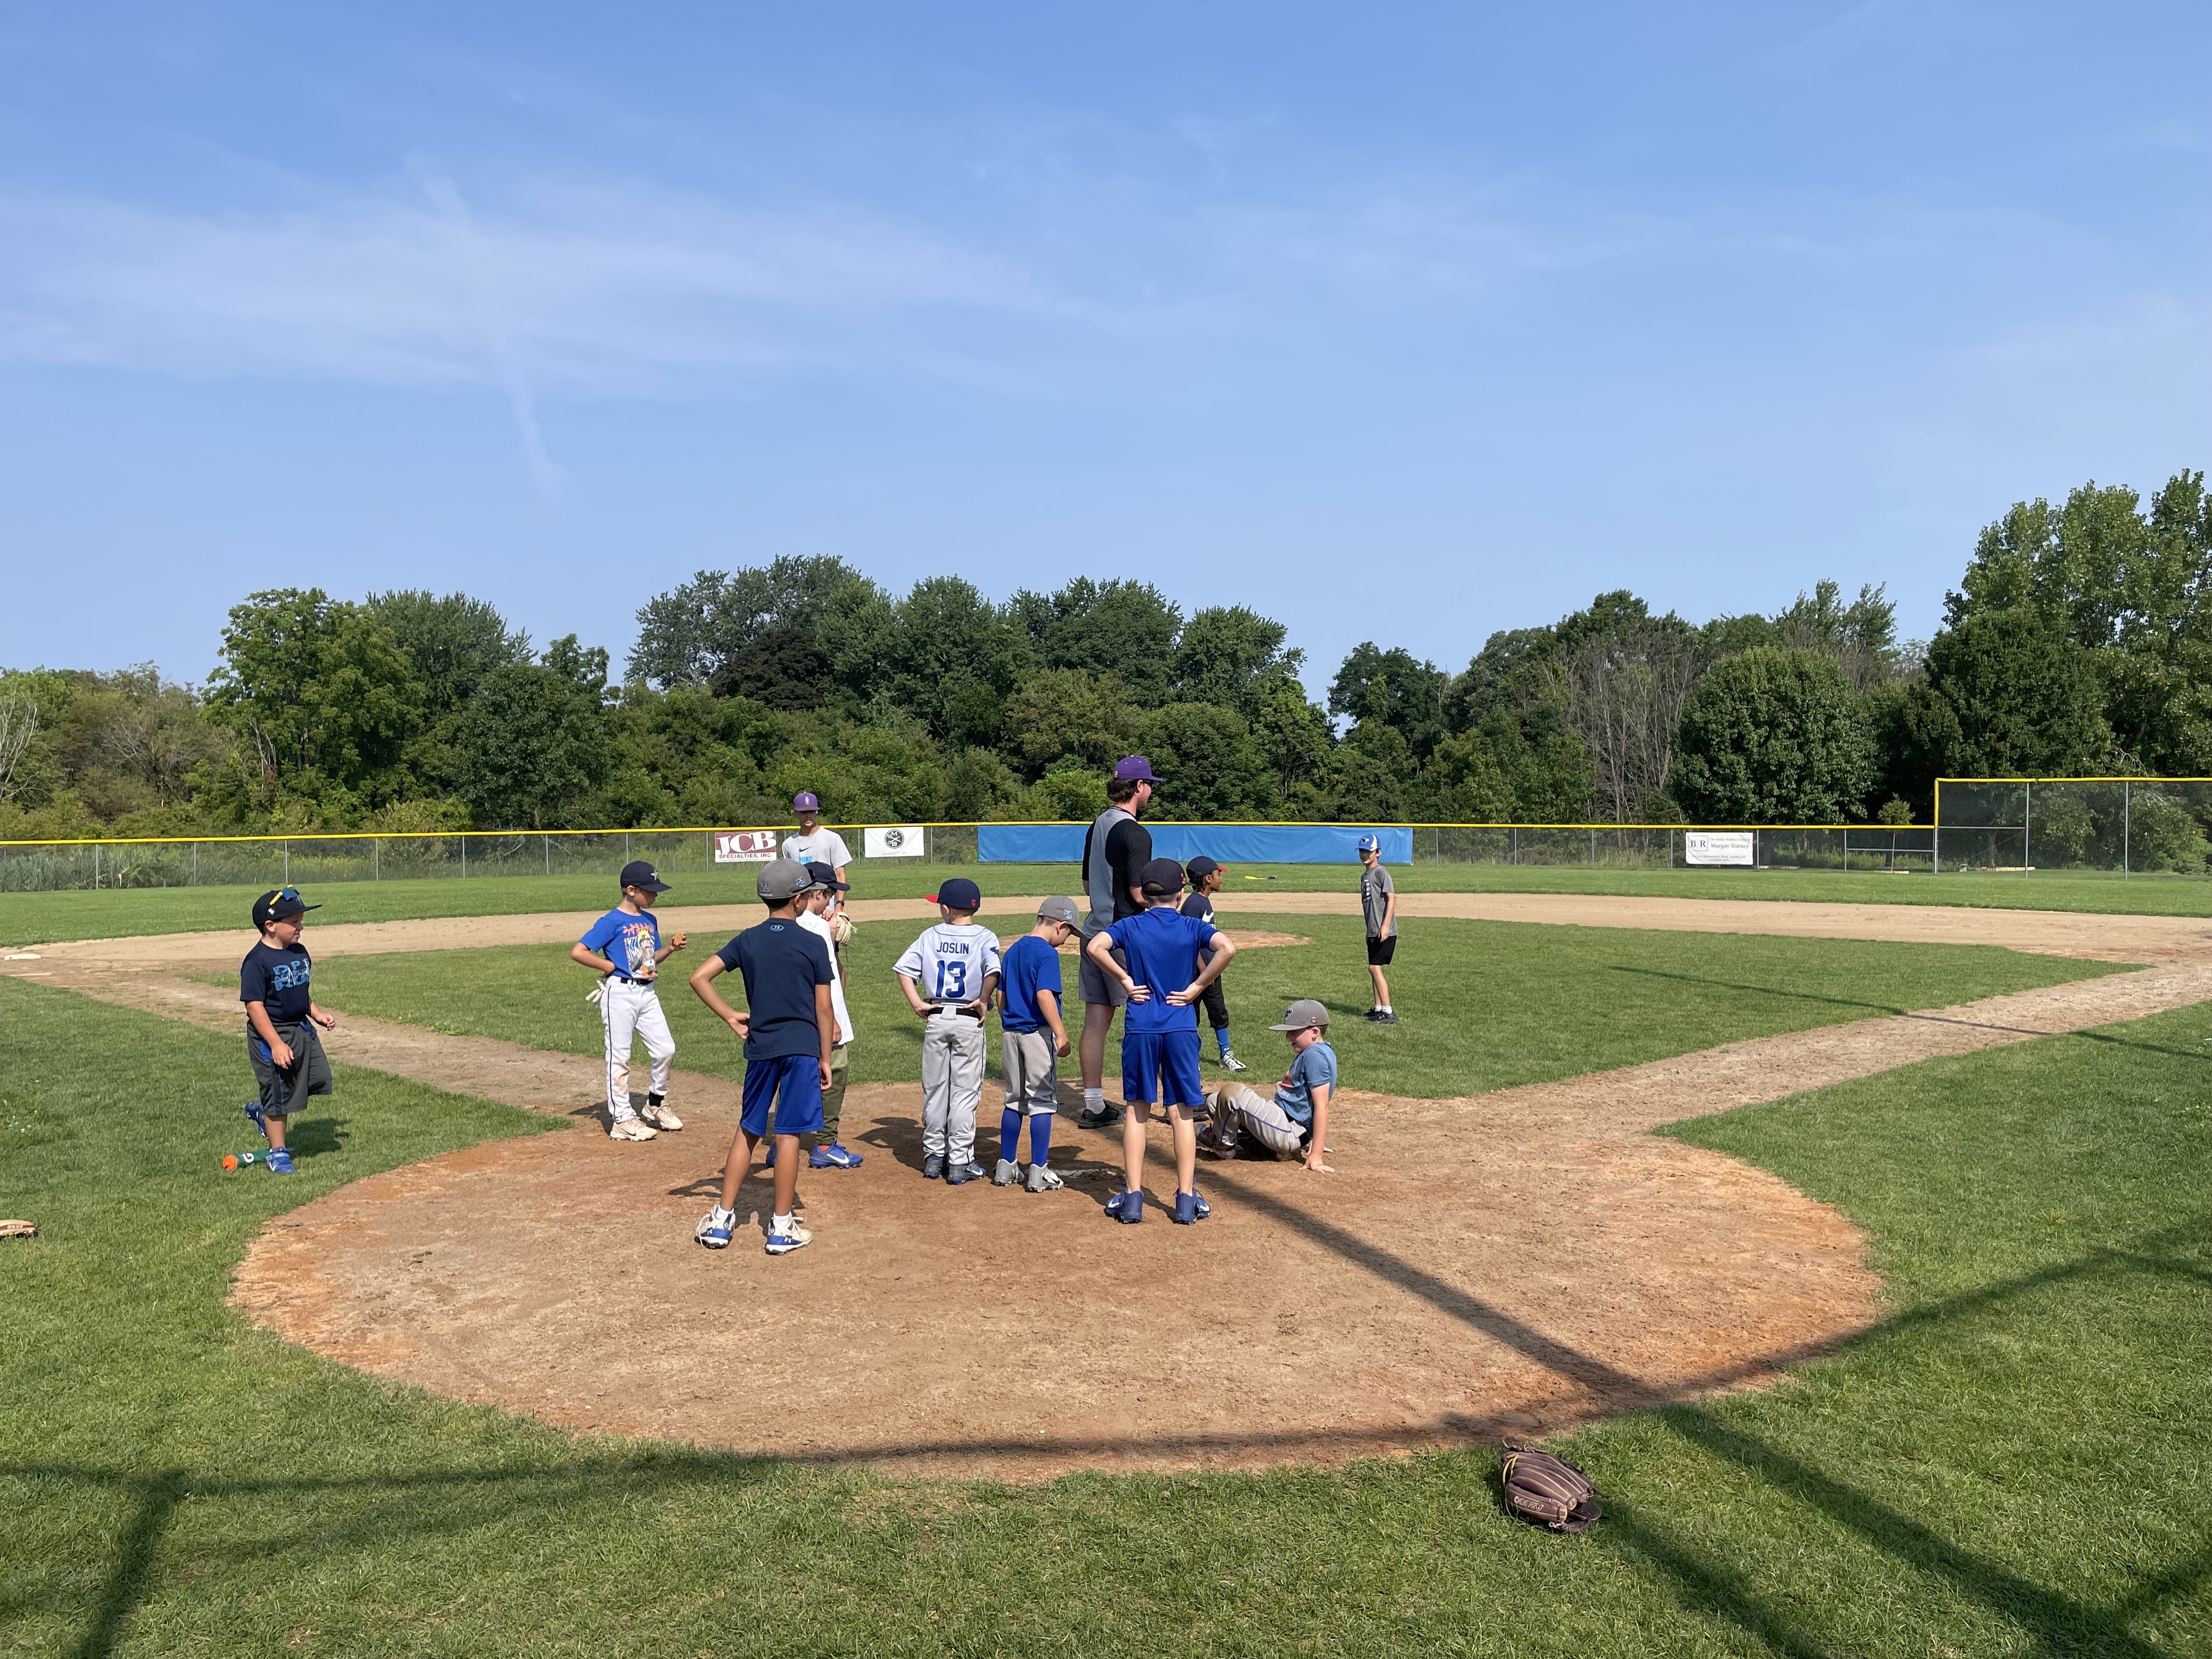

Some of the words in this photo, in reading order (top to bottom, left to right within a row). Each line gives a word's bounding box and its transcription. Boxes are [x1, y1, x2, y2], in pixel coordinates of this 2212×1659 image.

[715, 831, 776, 854] JCB
[936, 941, 969, 954] JOSLIN
[935, 960, 967, 998] 13
[1514, 1496, 1544, 1511] A2000
